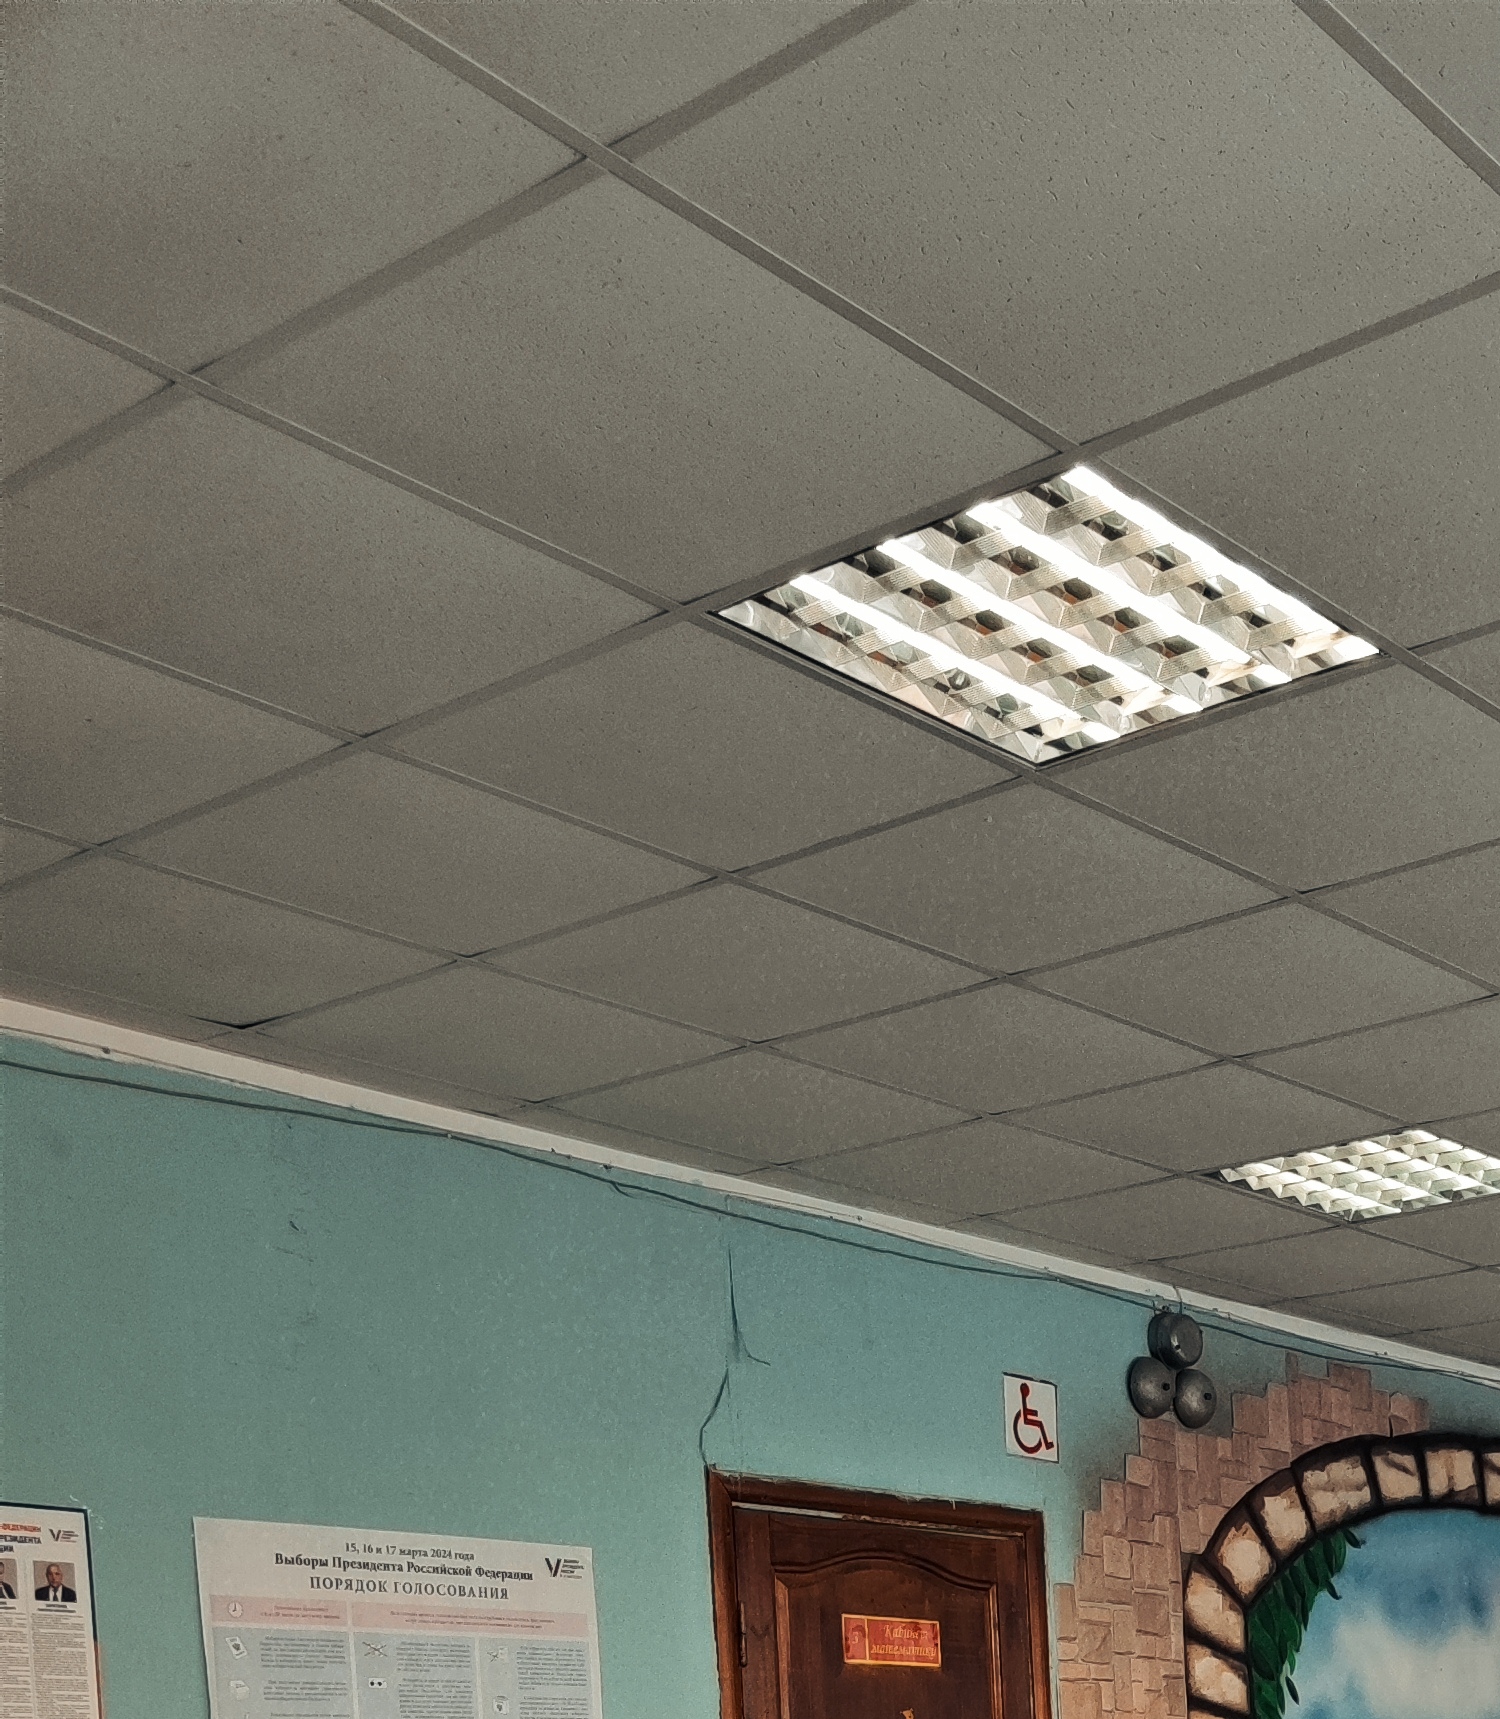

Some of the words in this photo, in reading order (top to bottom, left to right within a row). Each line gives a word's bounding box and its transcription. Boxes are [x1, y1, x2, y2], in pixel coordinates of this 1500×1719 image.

[345, 1542, 360, 1554] 15,
[363, 1543, 374, 1554] 16
[375, 1546, 383, 1554] и
[385, 1545, 397, 1556] 17
[399, 1549, 429, 1560] марта
[430, 1548, 453, 1559] 2024
[454, 1552, 475, 1561] года
[274, 1553, 329, 1570] Выборы
[332, 1556, 404, 1573] Президента
[406, 1561, 473, 1577] Российской
[475, 1565, 534, 1583] Федерации
[310, 1576, 389, 1594] ПОРЯДОК
[393, 1581, 509, 1600] ГОЛОСОВАНИЯ
